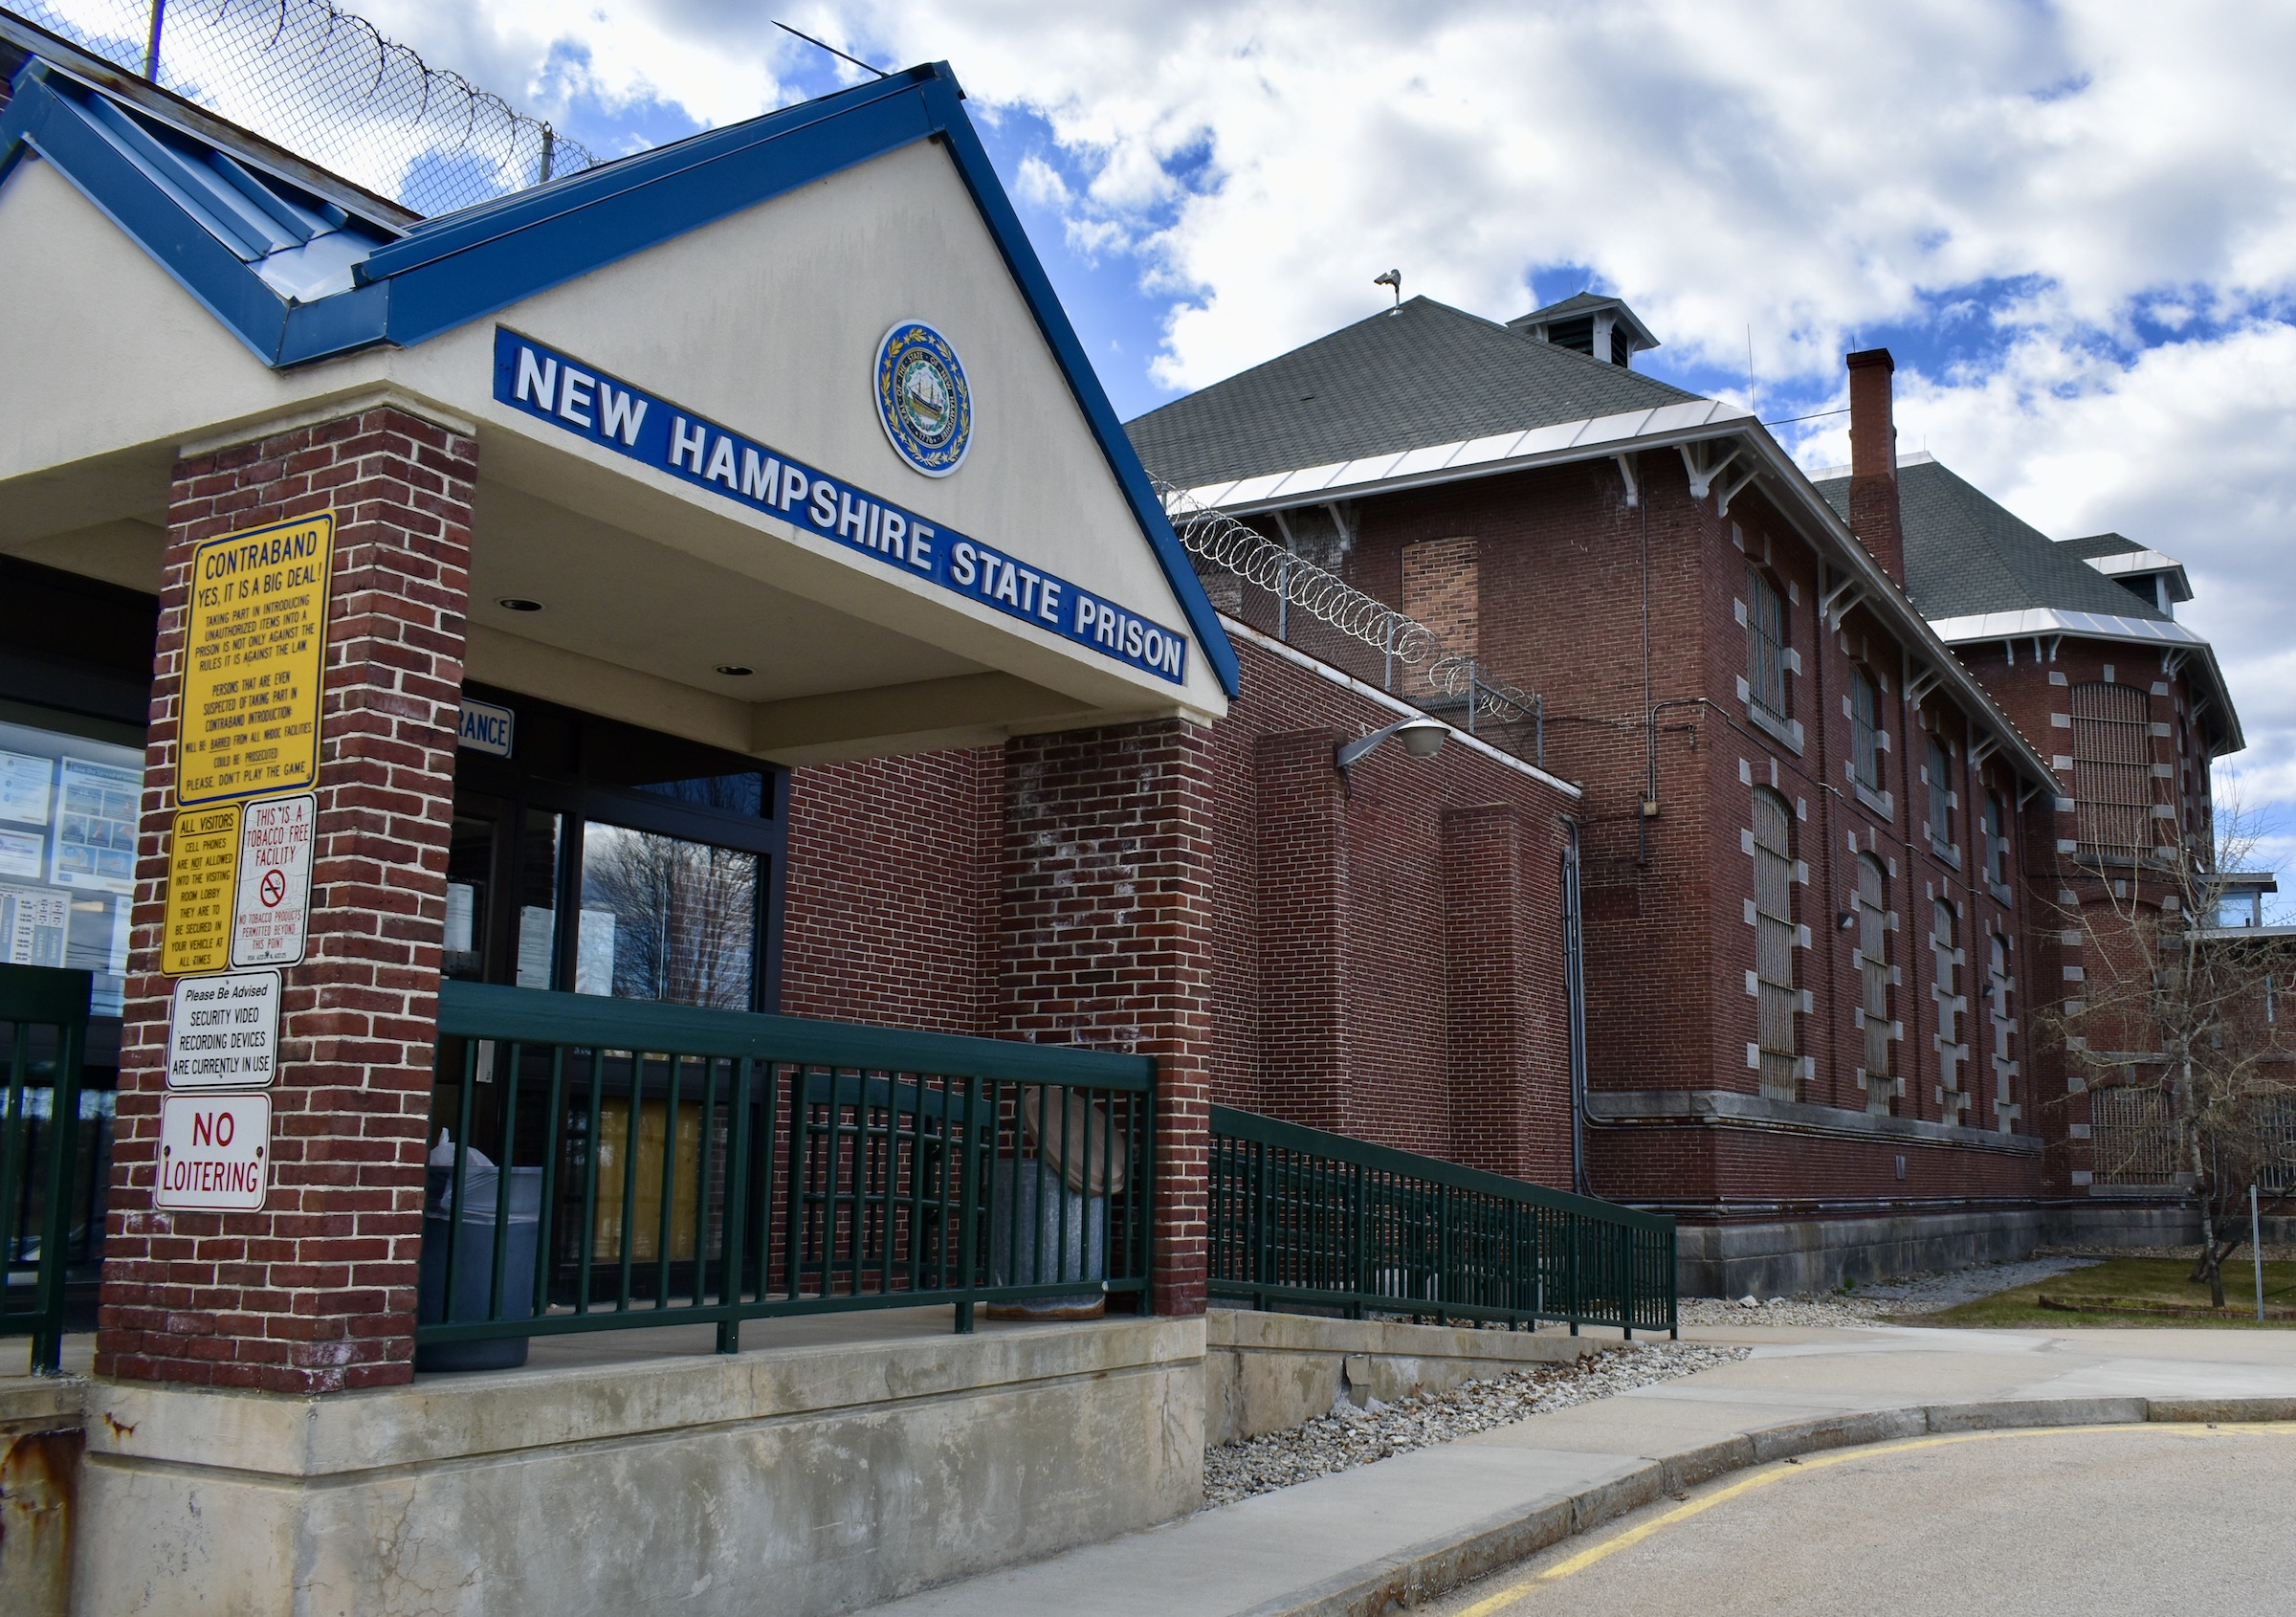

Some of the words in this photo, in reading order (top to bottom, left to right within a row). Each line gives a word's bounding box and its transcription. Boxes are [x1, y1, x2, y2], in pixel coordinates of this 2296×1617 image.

[907, 351, 924, 363] STATE
[513, 345, 649, 447] NEW
[668, 415, 935, 571] HAMPSHIRE
[951, 542, 1062, 624] STATE
[1073, 595, 1181, 677] PRISON
[206, 531, 318, 580] CONTRABAND
[198, 587, 221, 609] YES,
[224, 583, 234, 603] IT
[238, 579, 249, 599] IS
[252, 577, 259, 596] A
[263, 571, 282, 593] BIG
[287, 562, 322, 588] DEAL!
[206, 612, 230, 628] TAKING
[232, 608, 250, 622] PART
[253, 606, 260, 617] IN
[263, 594, 310, 613] INTRODUCING
[205, 621, 256, 642] UNAUTHORIZED
[259, 615, 280, 631] ITEMS
[283, 611, 299, 627] INTO
[301, 609, 307, 621] A
[195, 643, 219, 658] PRISON
[223, 641, 230, 653] IS
[232, 637, 246, 651] NOT
[248, 633, 266, 648] ONLY
[269, 626, 298, 643] AGAINST
[302, 623, 315, 635] THE
[199, 657, 222, 672] RULES
[225, 655, 231, 667] IT
[233, 653, 241, 665] IS
[243, 647, 273, 663] AGAINST
[276, 643, 289, 656] THE
[292, 639, 308, 653] LAW.
[212, 680, 239, 697] PERSONS
[242, 677, 256, 691] THAT
[259, 675, 271, 688] ARE
[275, 671, 291, 685] EVEN
[203, 698, 236, 716] SUSPECTED
[239, 696, 247, 709] OF
[249, 692, 269, 707] TAKING
[273, 688, 288, 703] PART
[291, 687, 298, 700] IN
[206, 714, 245, 733] CONTRABAND
[185, 742, 197, 754] WILL
[210, 736, 231, 750] BARRED
[233, 734, 248, 746] FROM
[251, 731, 260, 743] ALL
[263, 727, 281, 741] NHDOC
[213, 755, 231, 768] COULD
[245, 747, 278, 764] PROSECUTED
[219, 771, 240, 786] DON'T
[243, 767, 263, 782] PLAY
[266, 765, 280, 778] THE
[284, 761, 306, 776] GAME
[180, 819, 195, 834] ALL
[200, 812, 234, 831] VISITORS
[256, 808, 276, 828] THIS
[281, 806, 290, 824] IS
[296, 805, 302, 822] A
[185, 842, 199, 853] CELL
[203, 838, 227, 851] PHONES
[247, 827, 284, 848] TOBACCO
[289, 824, 309, 844] FREE
[176, 859, 188, 871] ARE
[191, 857, 203, 869] NOT
[206, 853, 233, 867] ALLOWED
[255, 846, 297, 867] FACILITY
[176, 875, 189, 886] INTO
[192, 873, 203, 884] THE
[206, 870, 231, 883] VISITING
[181, 891, 198, 902] ROOM
[201, 888, 221, 900] LOBBY
[180, 907, 195, 919] THEY
[197, 905, 210, 917] ARE
[212, 904, 220, 916] TO
[239, 914, 247, 925] NO
[249, 912, 273, 925] TOBACCO
[276, 909, 301, 923] PRODUCTS
[175, 925, 183, 936] BE
[186, 921, 212, 935] SECURED
[215, 920, 222, 932] IN
[242, 924, 272, 938] PERMITTED
[274, 922, 296, 936] BEYOND
[171, 941, 187, 952] YOUR
[189, 938, 213, 950] VEHICLE
[216, 937, 223, 948] AT
[252, 939, 265, 950] THIS
[267, 938, 284, 950] POINT
[179, 957, 190, 967] ALL
[193, 954, 211, 966] TIMES
[185, 989, 215, 1002] Please
[217, 987, 230, 1000] Be
[232, 984, 268, 998] Advised
[189, 1009, 232, 1027] SECURITY
[234, 1007, 259, 1024] VIDEO
[179, 1033, 228, 1052] RECORDING
[231, 1031, 266, 1049] DEVICES
[172, 1059, 190, 1075] ARE
[191, 1057, 240, 1074] CURRENTLY
[242, 1056, 252, 1073] IN
[253, 1055, 270, 1072] USE
[192, 1112, 234, 1147] NO
[163, 1161, 258, 1193] LOITERING
